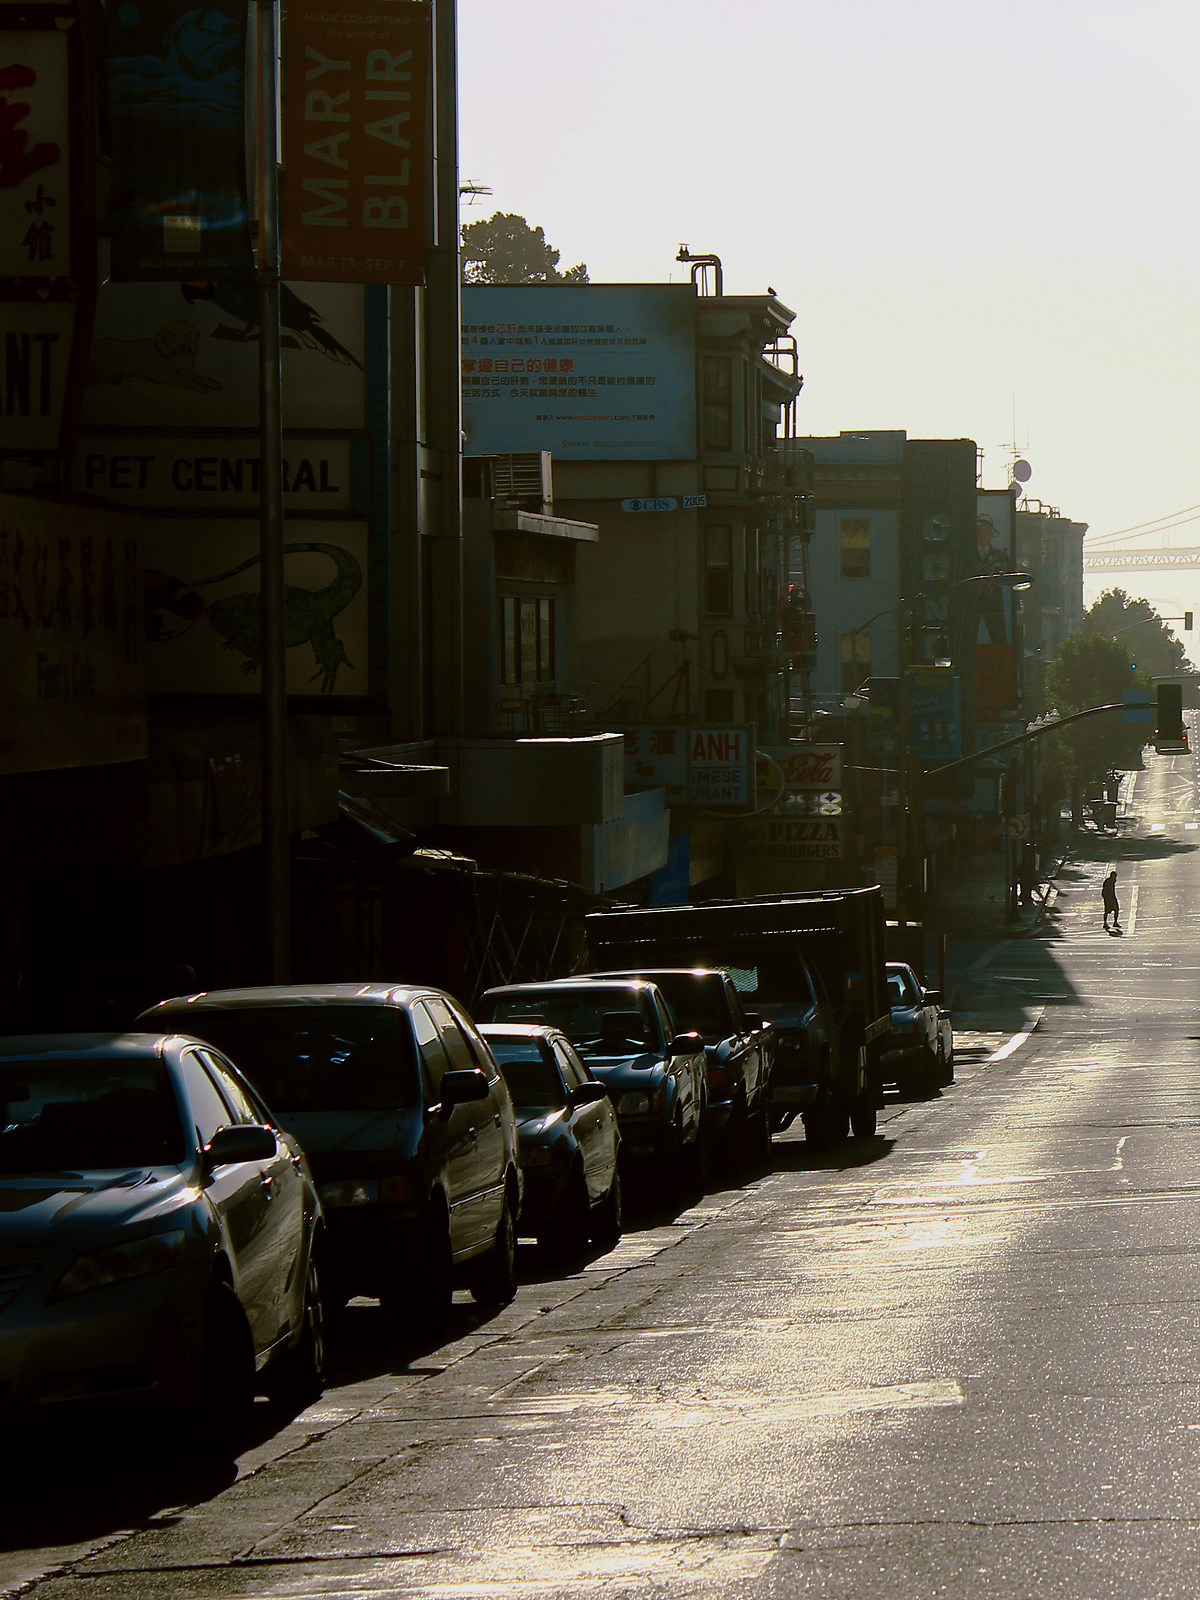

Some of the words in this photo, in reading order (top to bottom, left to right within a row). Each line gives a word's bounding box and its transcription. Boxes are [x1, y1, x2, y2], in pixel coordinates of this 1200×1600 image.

[304, 13, 339, 23] MAGIC
[343, 14, 380, 24] COLOR
[384, 15, 412, 25] FLAIR
[326, 29, 343, 38] the
[346, 29, 376, 39] world
[379, 30, 391, 39] of
[301, 46, 351, 226] MARY
[362, 48, 412, 229] BLAIR
[300, 256, 336, 269] MAR
[397, 259, 406, 272] 7
[0, 333, 59, 416] NT
[86, 455, 155, 489] PET
[644, 497, 670, 511] CBS
[684, 496, 706, 507] 2005
[691, 733, 741, 762] ANH
[767, 822, 841, 841] PIZZA
[750, 843, 839, 859] HAMBURGERS
